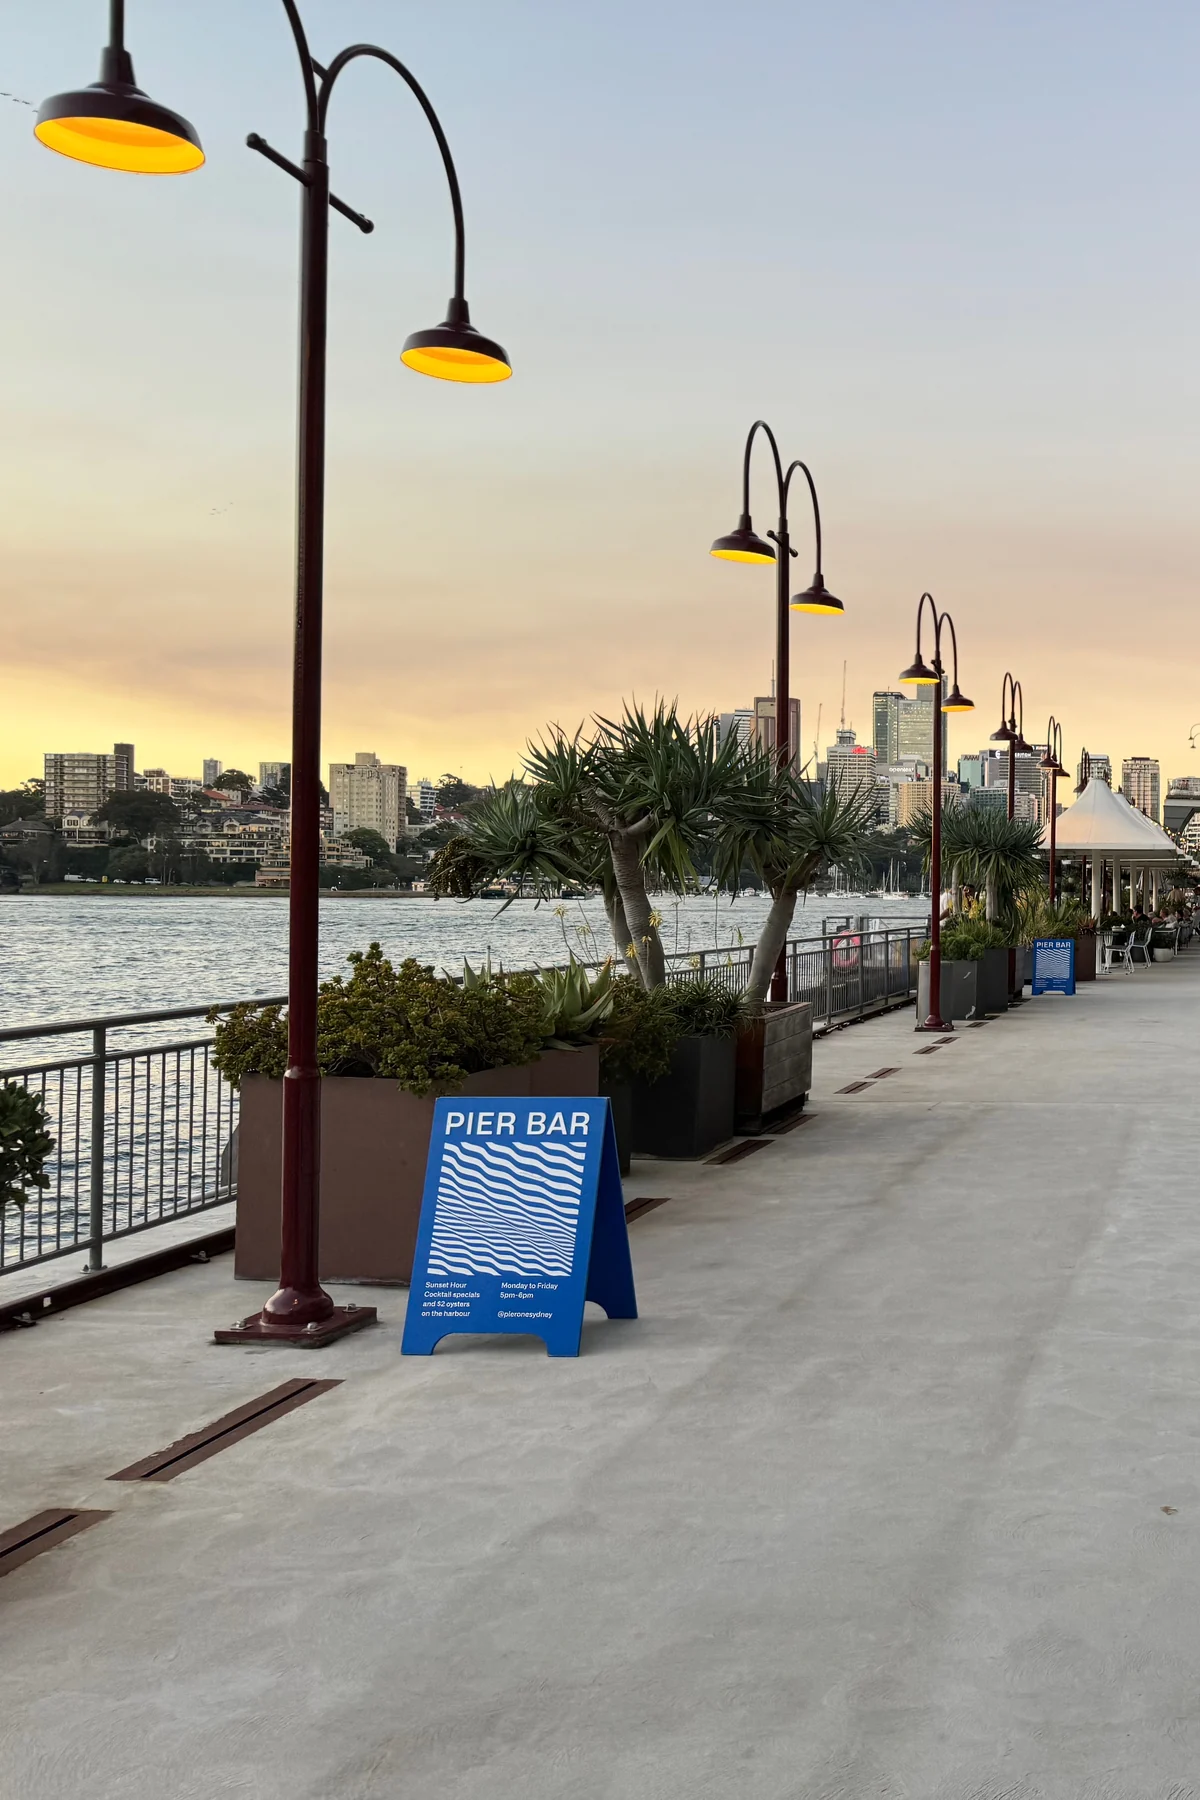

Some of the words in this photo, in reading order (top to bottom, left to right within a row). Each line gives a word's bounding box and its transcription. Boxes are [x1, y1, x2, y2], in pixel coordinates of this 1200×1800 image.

[445, 1112, 516, 1135] PIER
[526, 1112, 590, 1135] BAR
[425, 1281, 449, 1289] Sunset
[450, 1281, 467, 1289] Hour
[501, 1282, 528, 1290] Monday
[537, 1282, 558, 1291] Friday
[423, 1290, 452, 1298] Cocktail
[452, 1291, 480, 1299] specials
[497, 1310, 553, 1319] @pieronesydney
